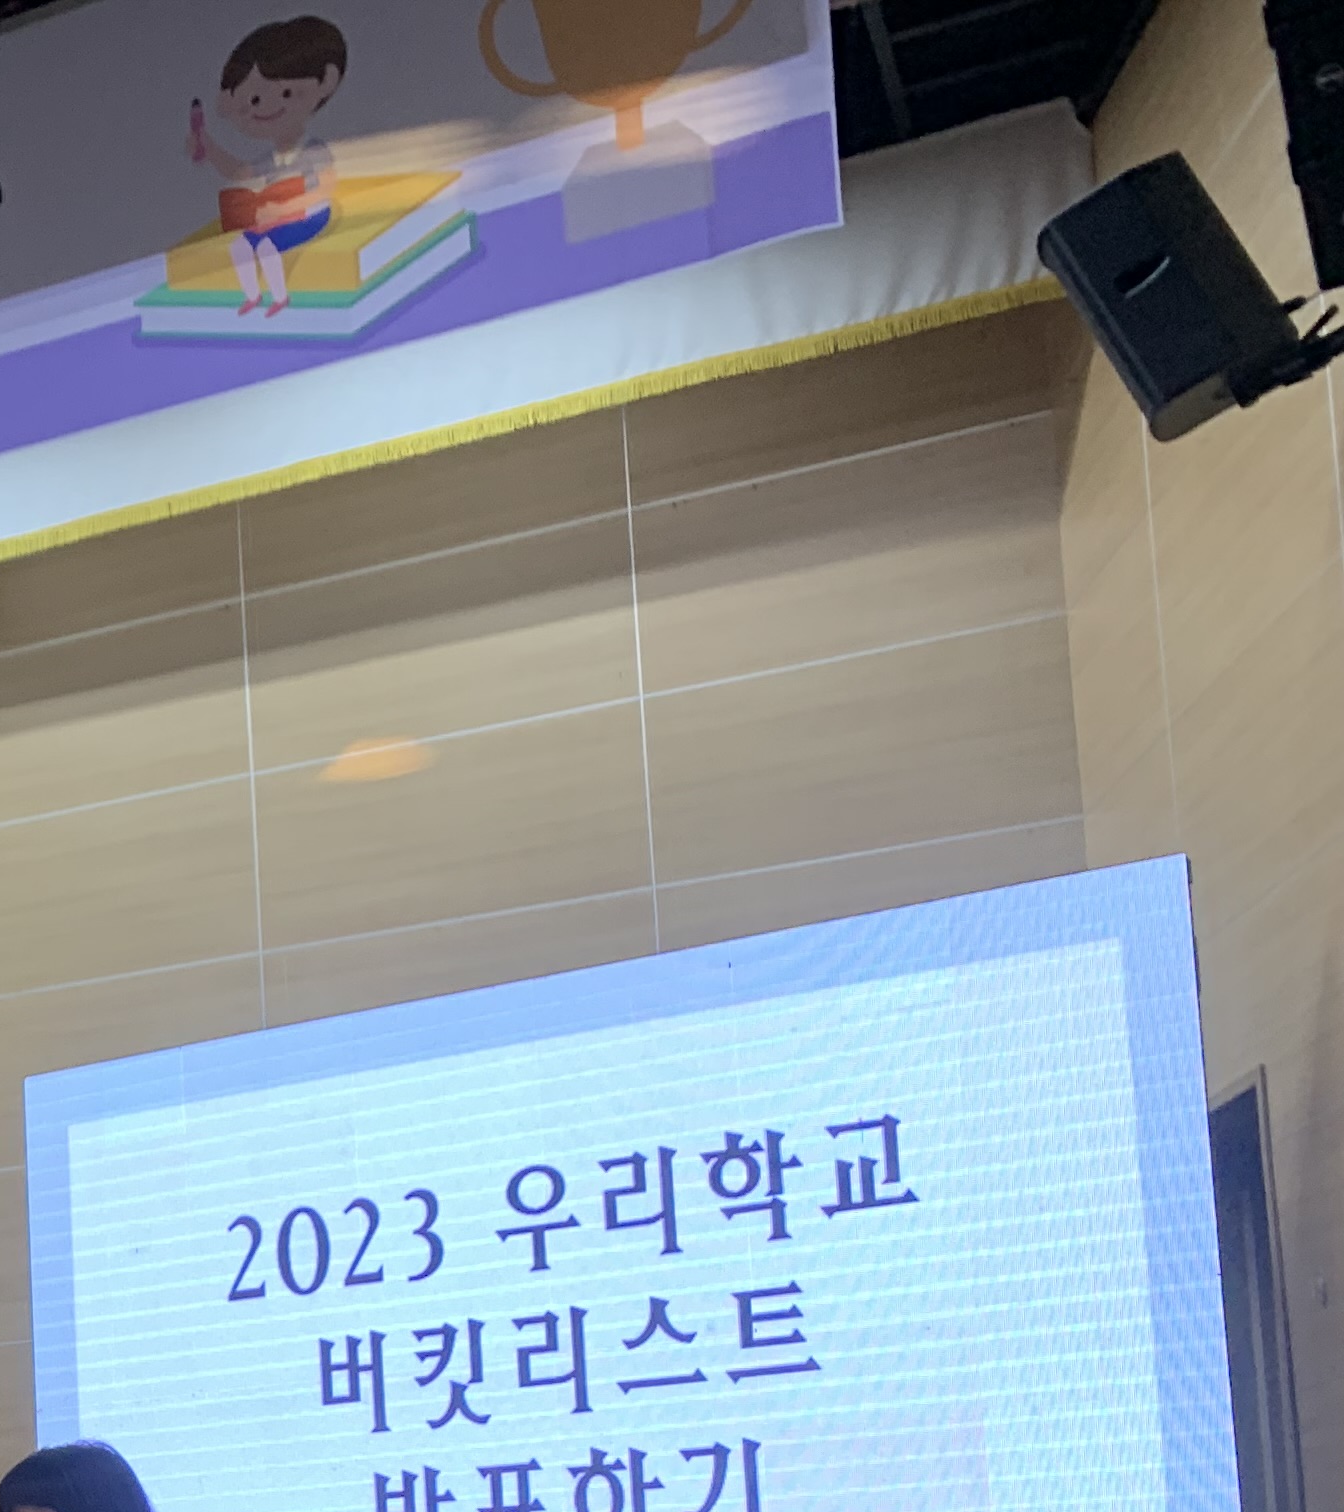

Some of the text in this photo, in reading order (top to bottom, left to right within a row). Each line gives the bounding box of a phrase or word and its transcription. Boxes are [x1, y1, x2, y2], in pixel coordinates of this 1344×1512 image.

[226, 1113, 920, 1302] 2023 우리학교
[318, 1281, 822, 1434] 버킷리스트
